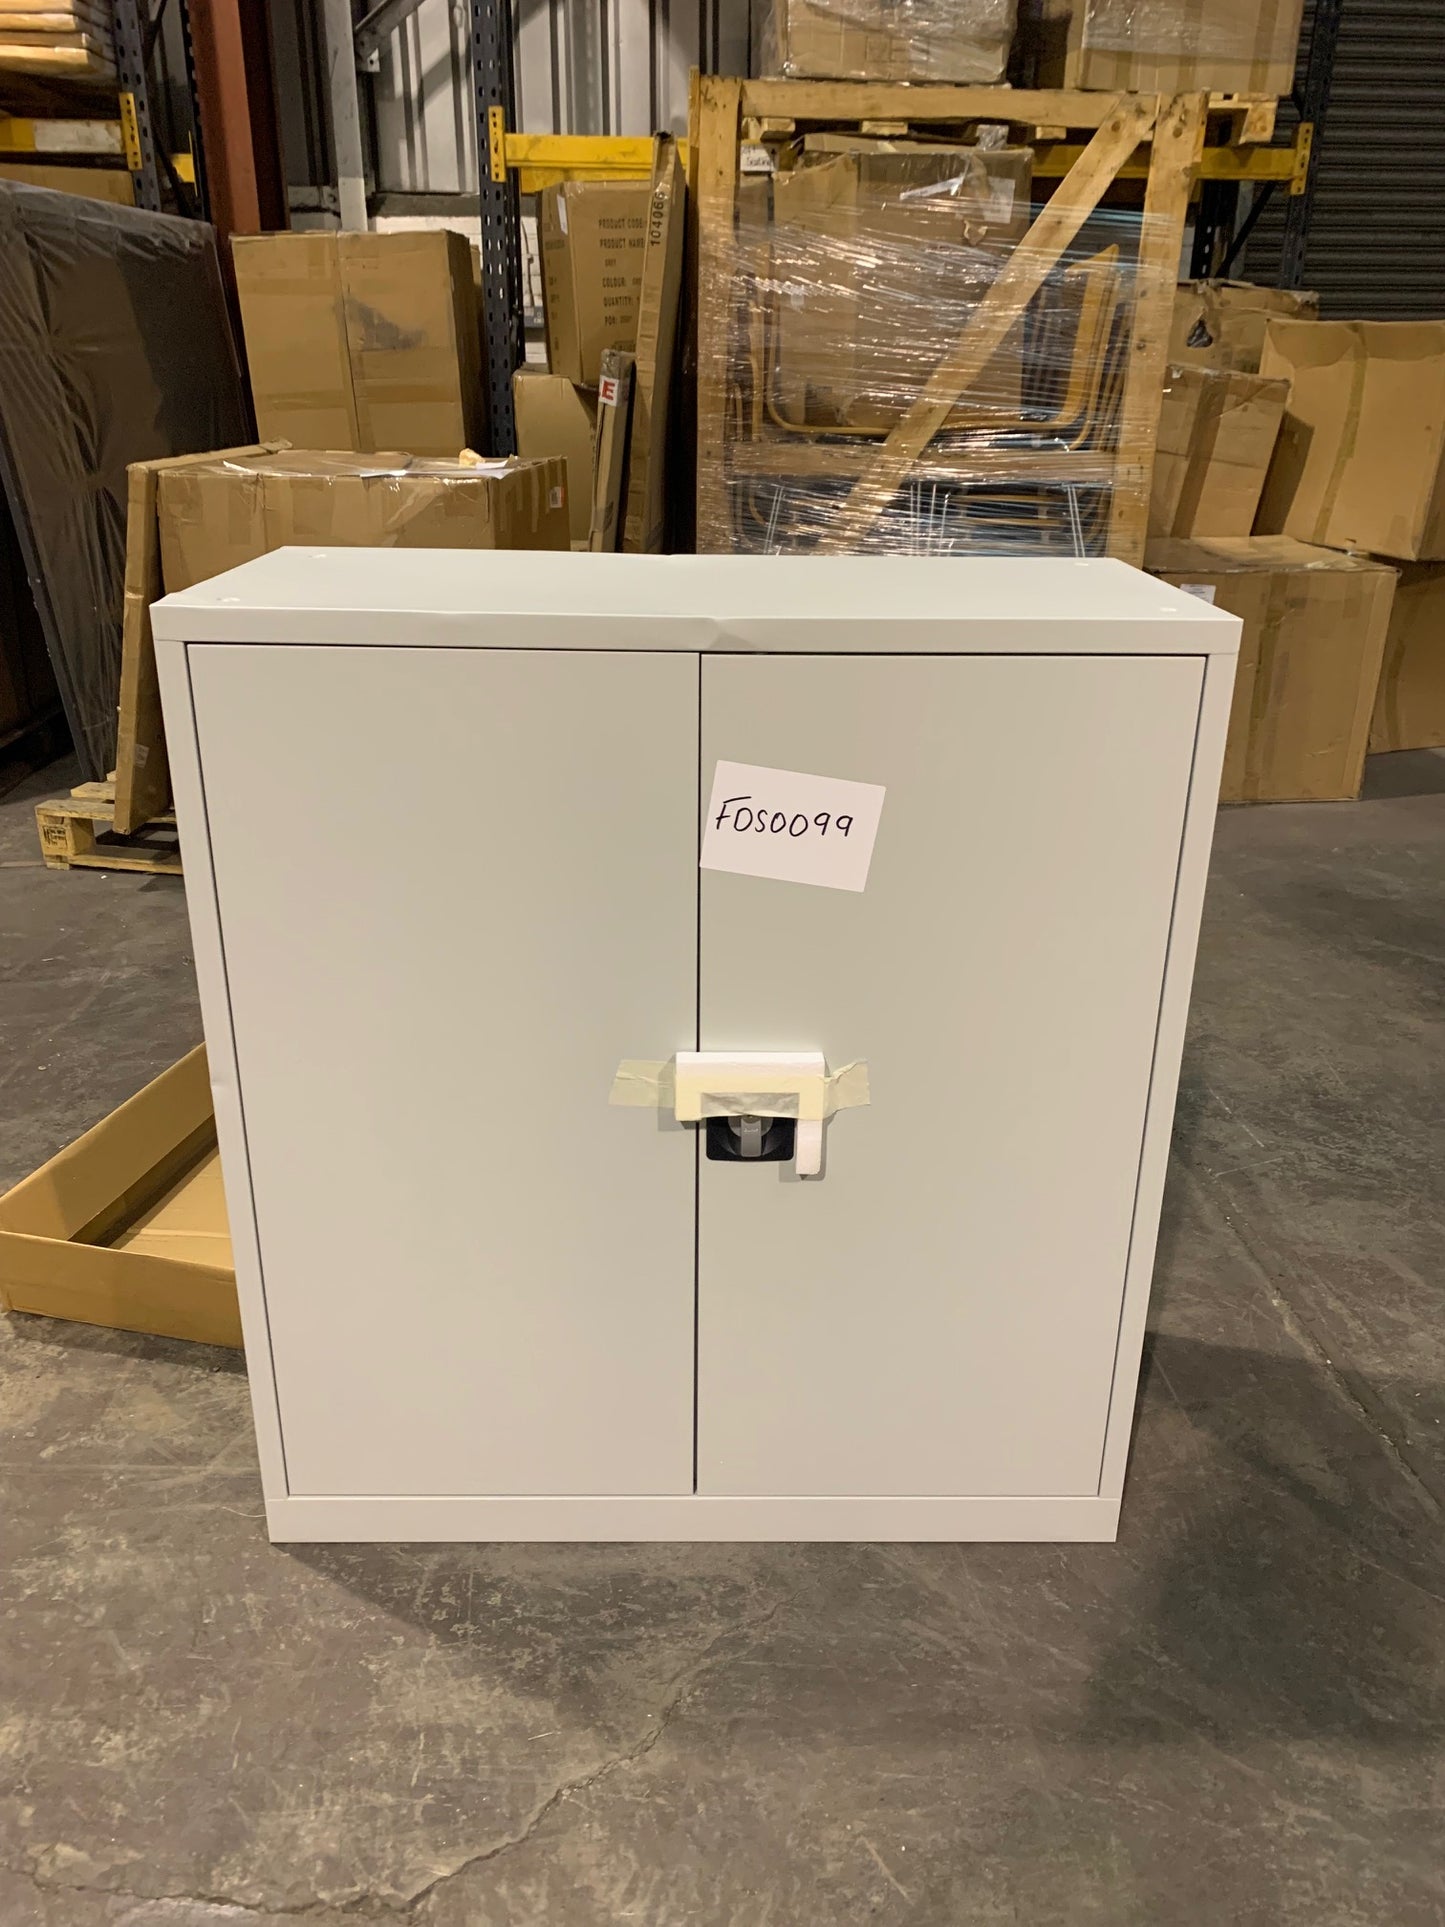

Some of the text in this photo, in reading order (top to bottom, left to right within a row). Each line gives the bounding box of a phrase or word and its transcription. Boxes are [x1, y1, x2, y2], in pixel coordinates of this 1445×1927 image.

[598, 217, 625, 229] PRODUCT
[650, 191, 666, 247] 104066
[599, 237, 626, 249] PRODUCT
